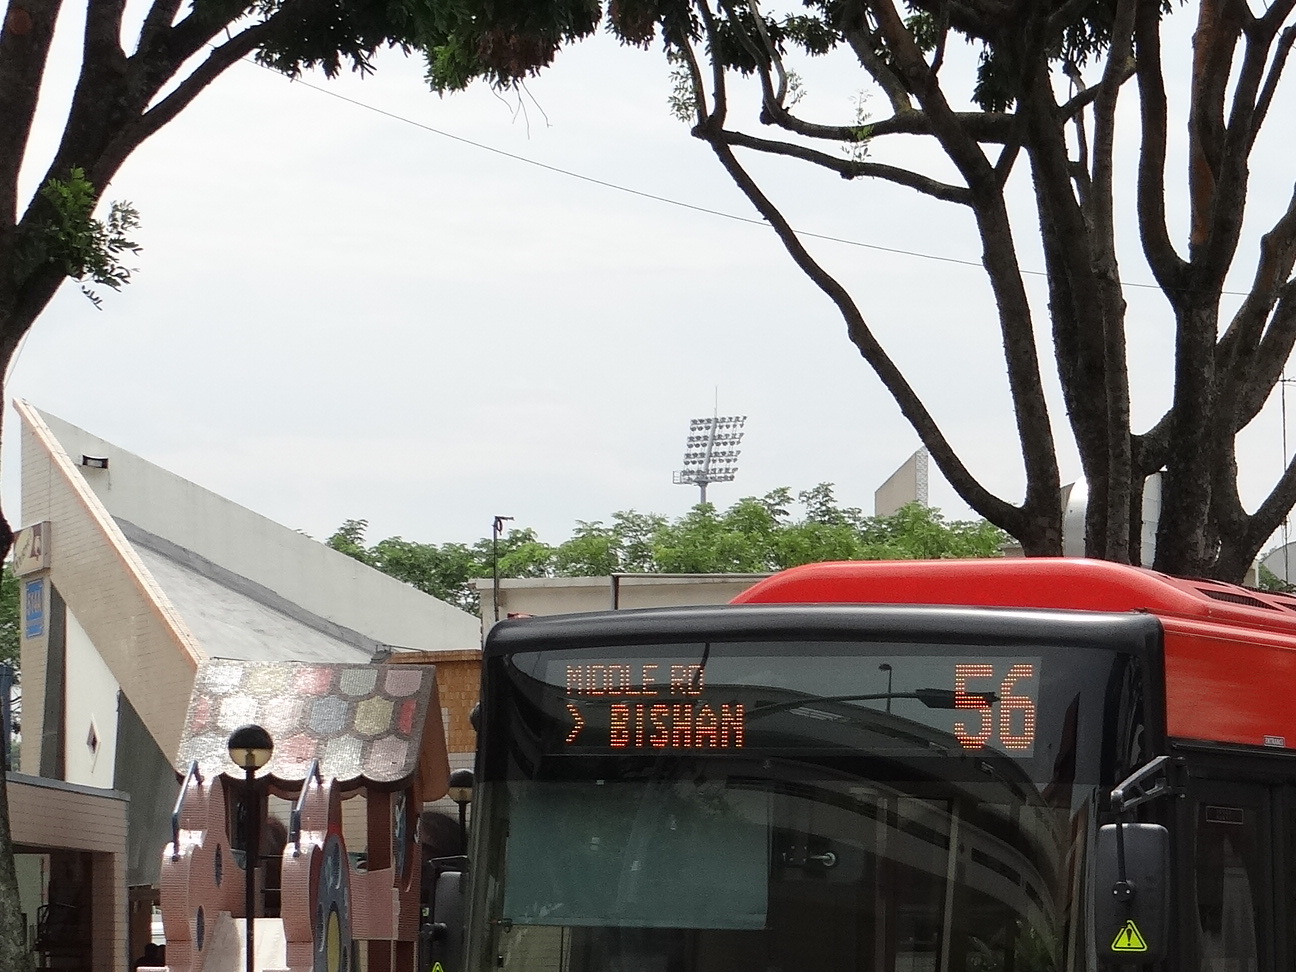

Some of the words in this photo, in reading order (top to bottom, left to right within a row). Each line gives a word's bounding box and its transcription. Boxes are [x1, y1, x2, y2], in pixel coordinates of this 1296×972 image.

[566, 664, 659, 695] MIDDLE
[671, 664, 704, 695] RD
[610, 703, 745, 748] BISHAN
[954, 664, 1035, 749] 56
